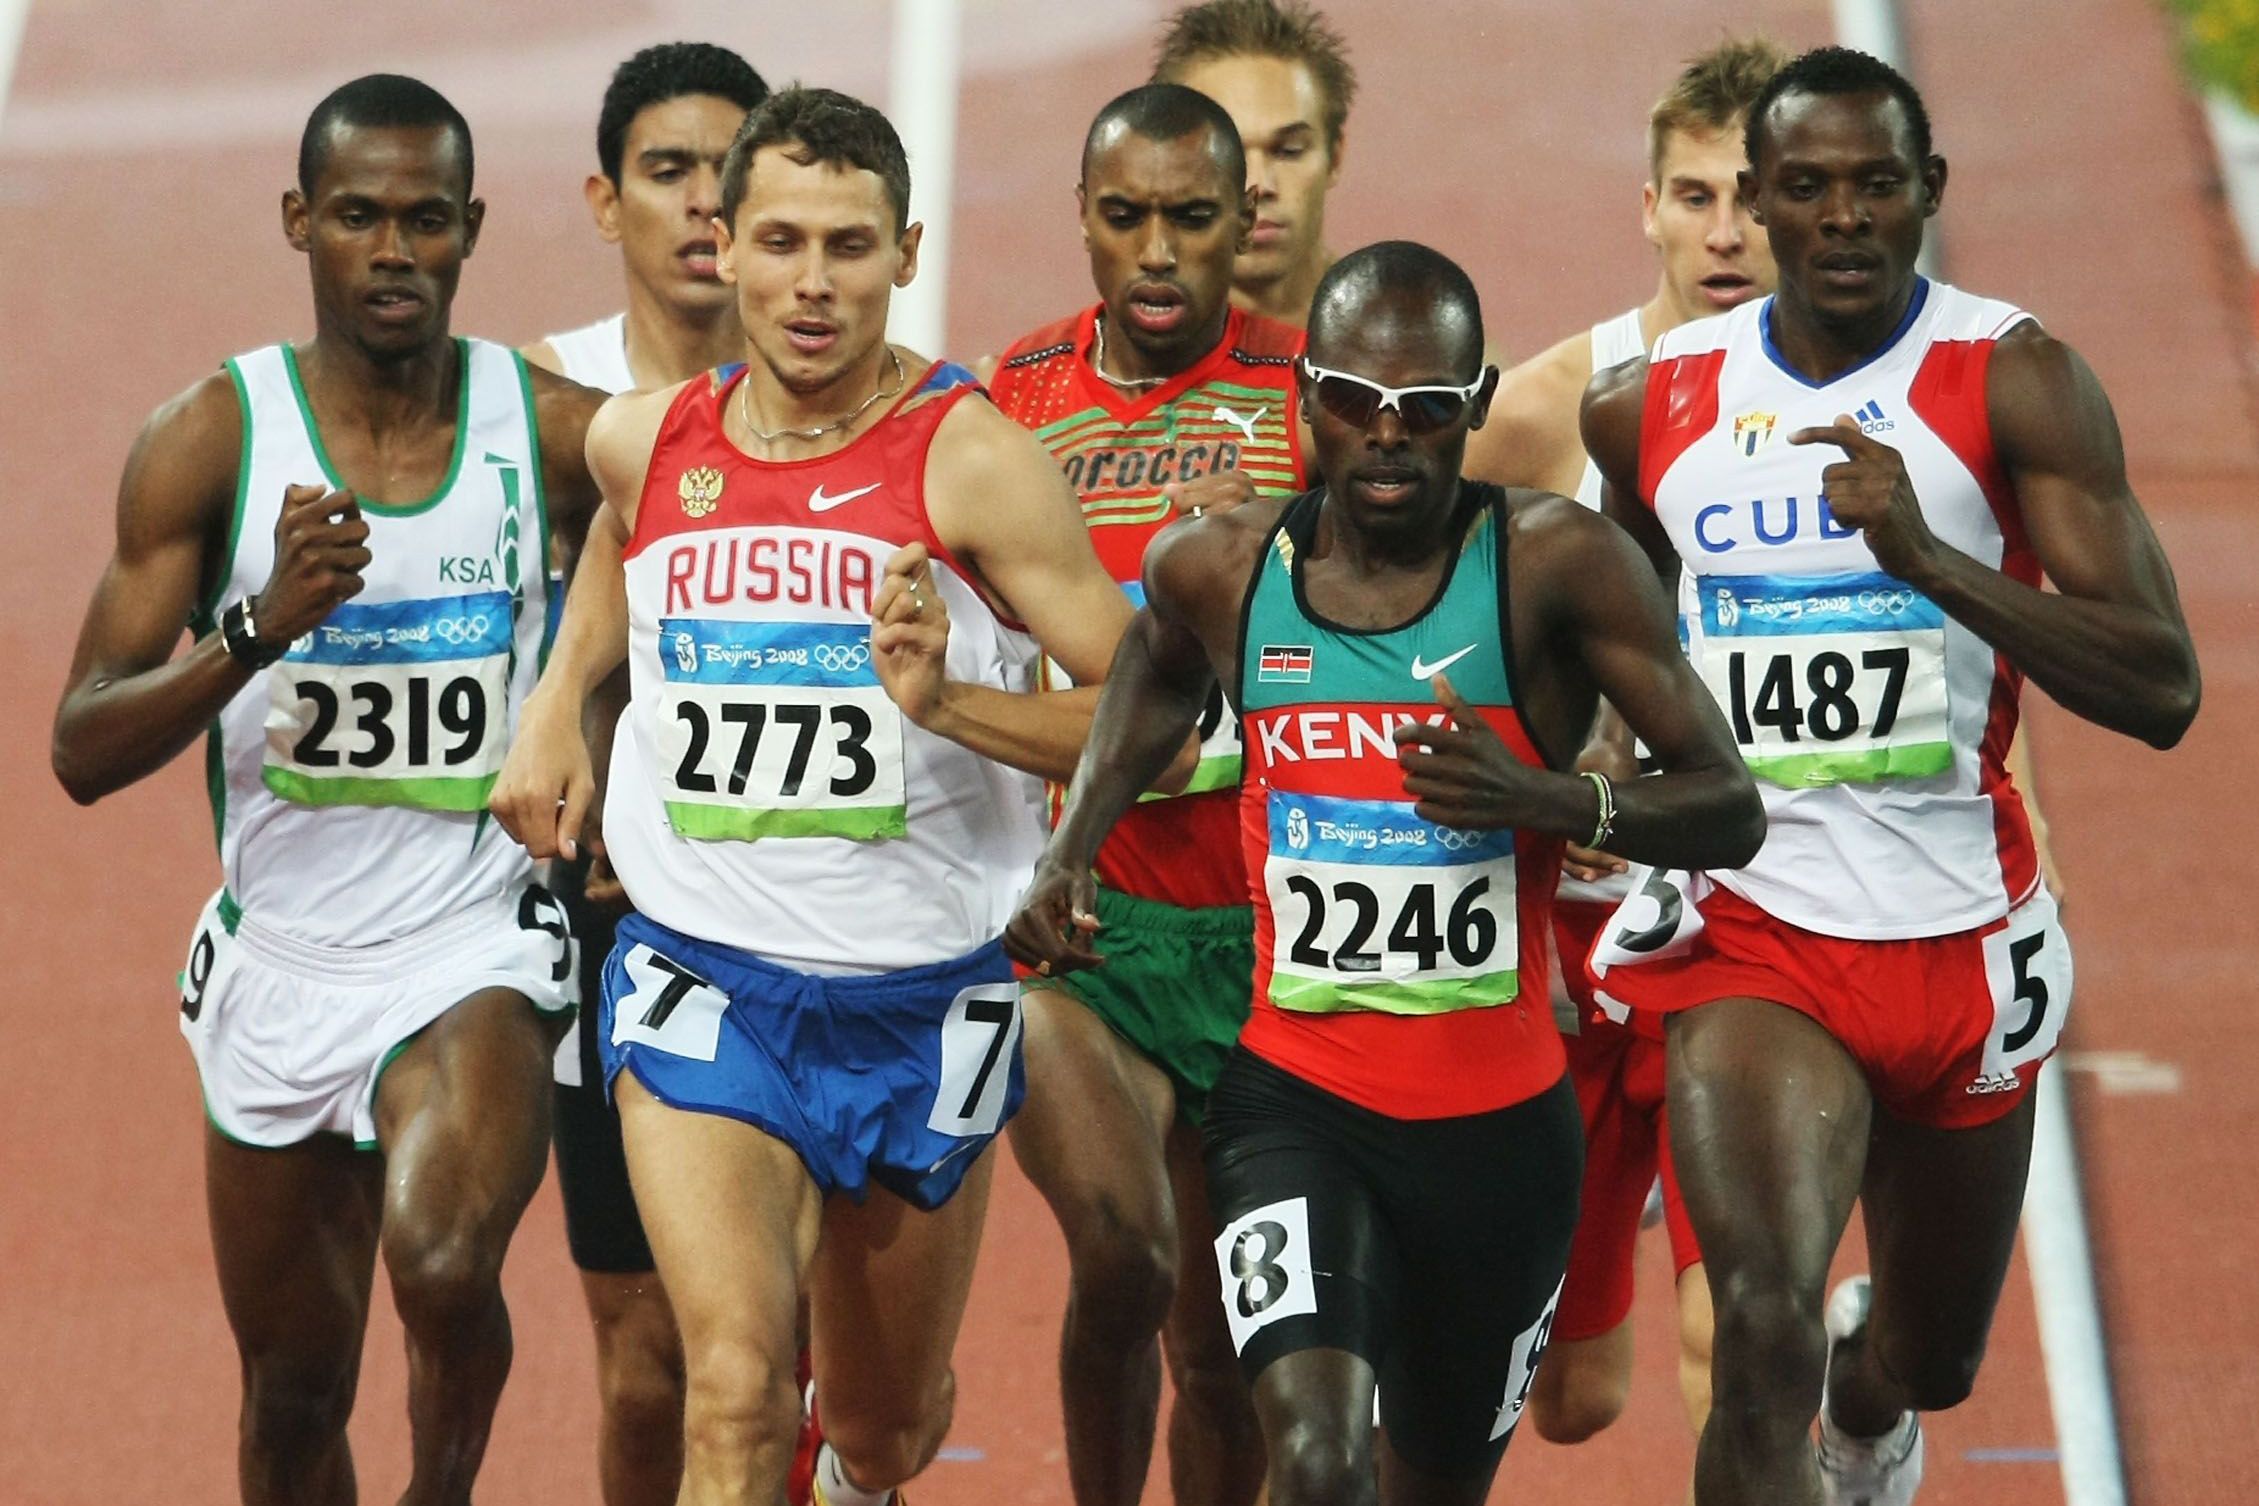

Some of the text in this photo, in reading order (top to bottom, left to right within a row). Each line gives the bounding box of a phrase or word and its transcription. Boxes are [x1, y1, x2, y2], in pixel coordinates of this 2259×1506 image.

[1863, 420, 1895, 434] das
[1064, 441, 1239, 491] orocco
[1694, 494, 1858, 553] CUB
[438, 557, 495, 584] KSA
[665, 538, 874, 615] RUSSIA
[1742, 594, 1850, 619] Beijing 2008
[321, 625, 431, 650] Beijing 2008
[702, 644, 809, 667] Beijing 2008
[293, 675, 488, 768] 2319
[1729, 647, 1911, 744] 1487
[674, 700, 877, 797] 2773
[1257, 711, 1460, 768] KENY
[1314, 821, 1427, 848] Beijing 2008
[518, 883, 572, 982] 9
[1286, 875, 1497, 972] 2246
[180, 929, 215, 1022] 9
[638, 953, 710, 1031] 7
[2003, 929, 2048, 1053] 5
[957, 1000, 1014, 1118] 7
[1230, 1221, 1288, 1318] 8
